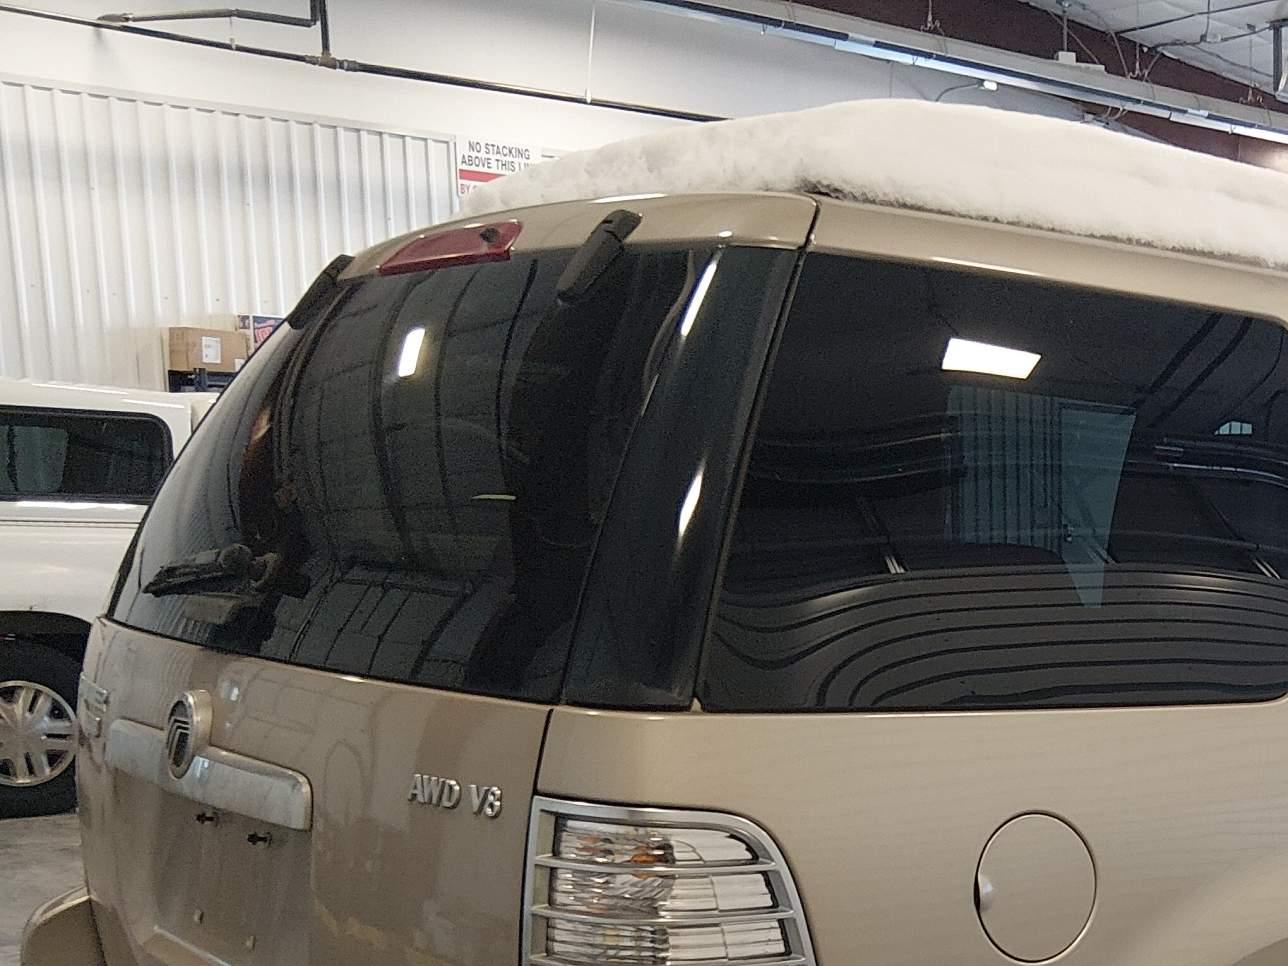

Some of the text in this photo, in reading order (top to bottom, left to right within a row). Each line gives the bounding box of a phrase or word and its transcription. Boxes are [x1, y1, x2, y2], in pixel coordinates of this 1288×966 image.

[468, 140, 531, 160] NO STACKING
[461, 154, 493, 169] ABOVE
[495, 159, 516, 173] THIS
[460, 184, 471, 195] BY
[408, 773, 503, 818] AWD V8
